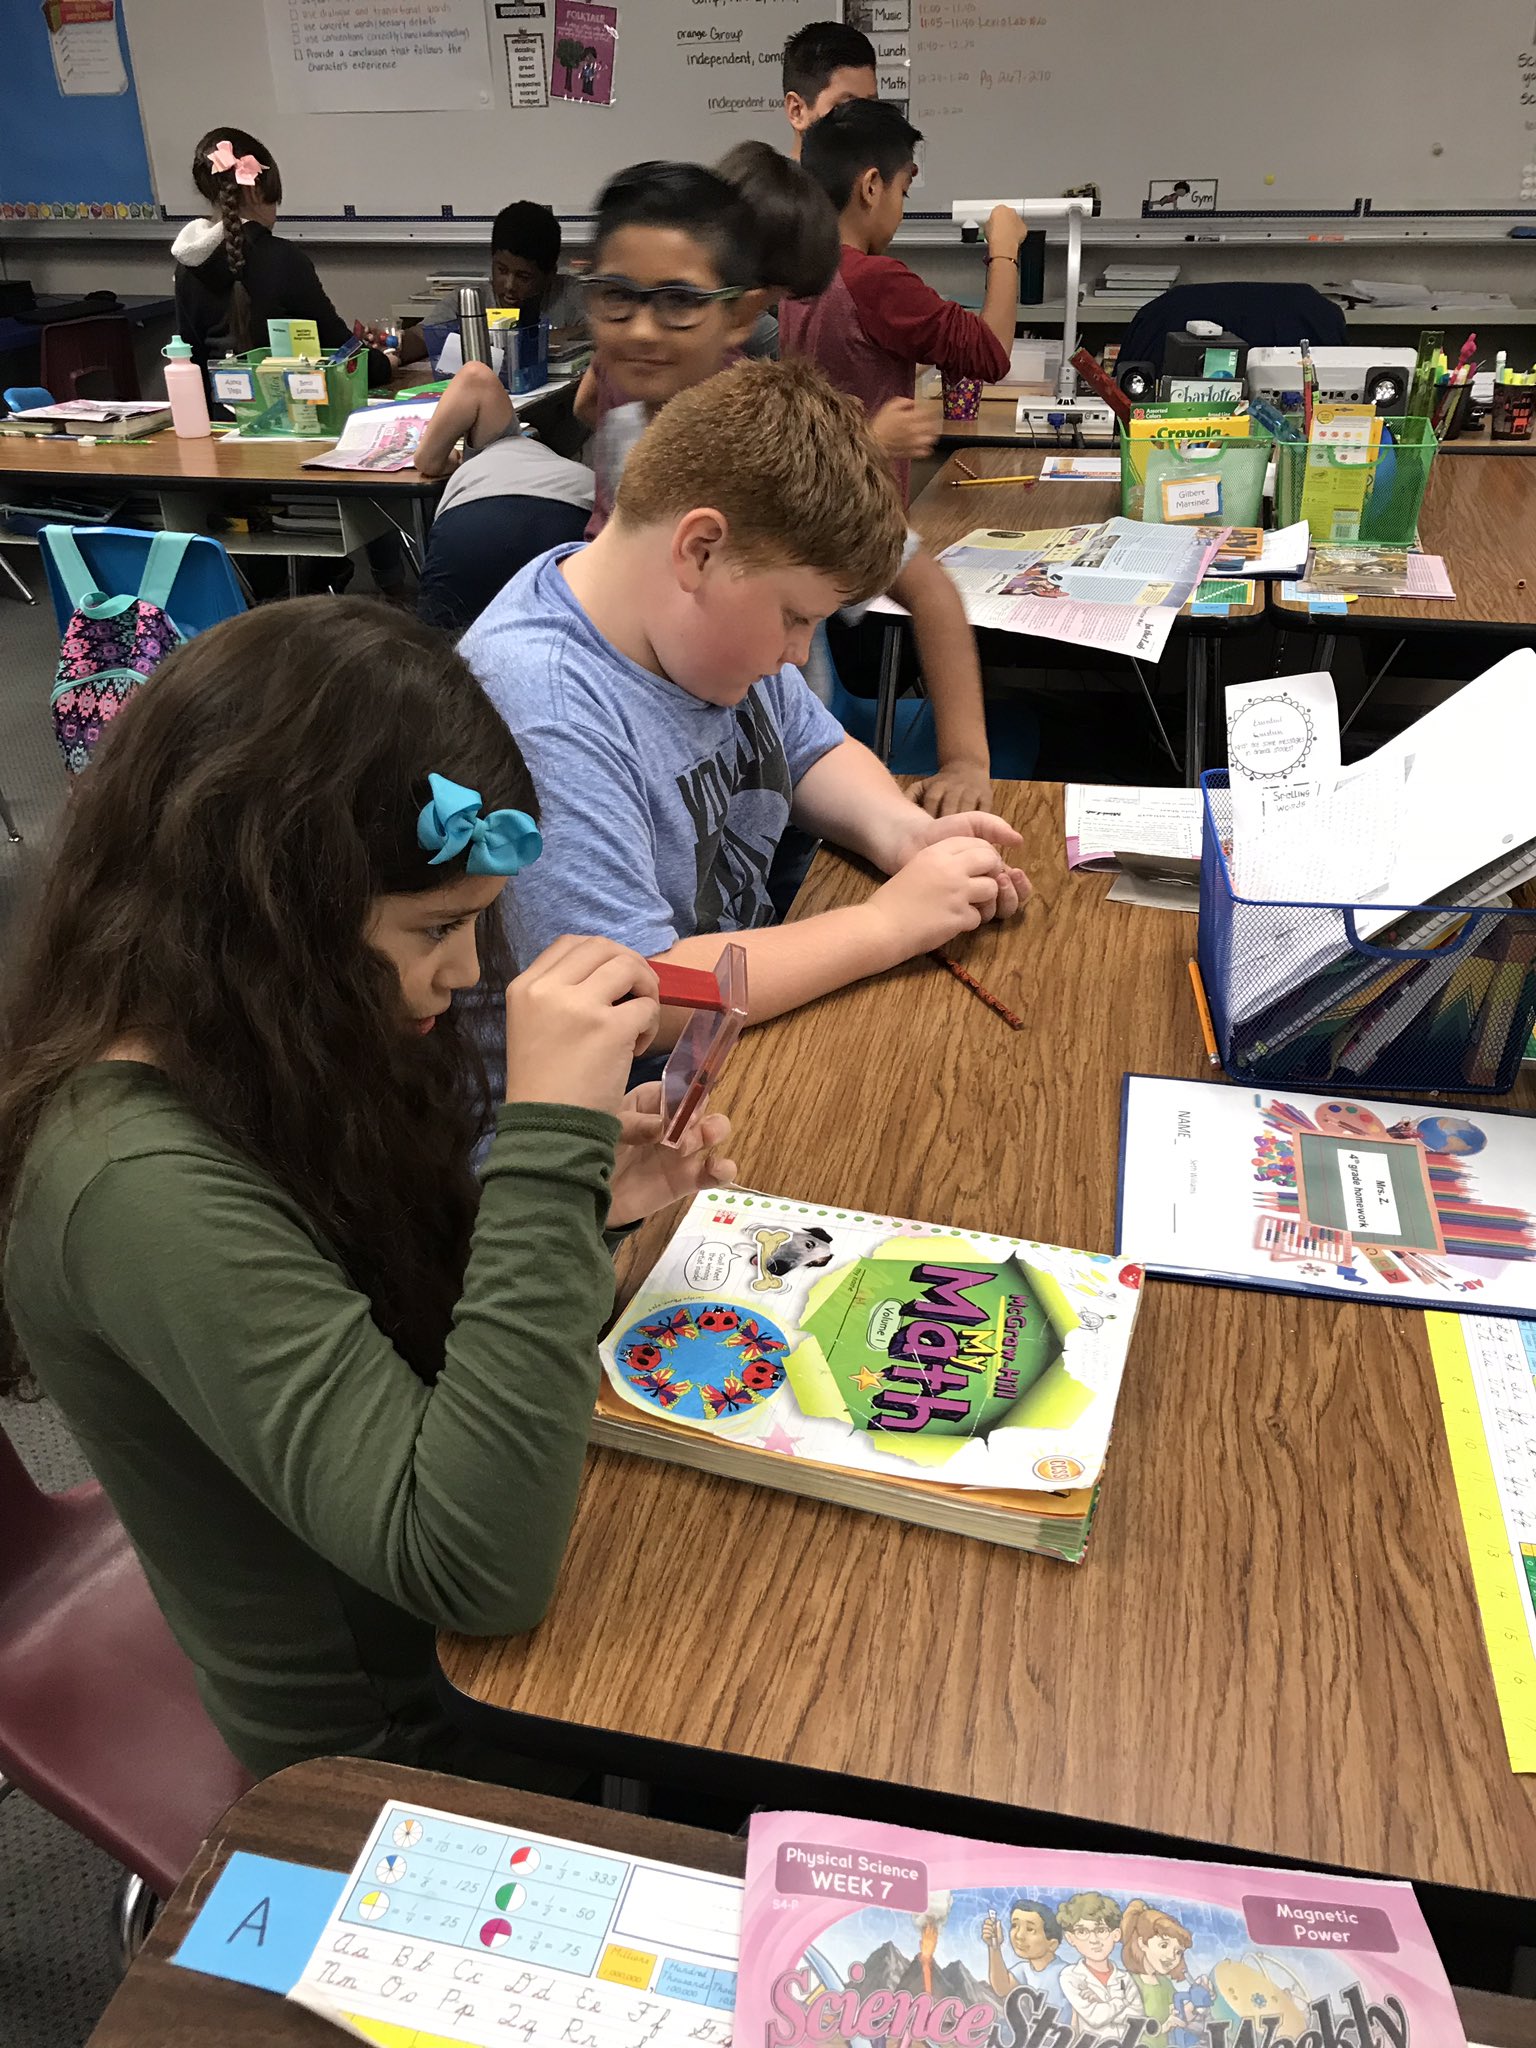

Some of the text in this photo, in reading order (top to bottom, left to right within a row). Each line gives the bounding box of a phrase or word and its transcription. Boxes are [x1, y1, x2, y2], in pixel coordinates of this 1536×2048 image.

[875, 9, 902, 21] Music
[710, 27, 744, 43] Group
[306, 48, 334, 58] Provide
[348, 47, 387, 57] conclusion
[391, 46, 409, 55] that
[414, 44, 443, 55] follows
[448, 43, 461, 54] the
[878, 44, 906, 57] Lunch
[881, 77, 907, 90] Math
[1191, 190, 1213, 207] Gym
[1157, 426, 1222, 439] Crayola
[1176, 498, 1210, 509] Martinez
[1178, 489, 1206, 499] Gilbert
[1137, 639, 1149, 650] Lab
[1177, 1110, 1191, 1139] NAME
[1348, 1164, 1362, 1186] grade
[1376, 1180, 1389, 1205] Mrs. Z.
[1354, 1187, 1369, 1228] homework
[848, 1277, 858, 1292] name
[877, 1307, 895, 1336] Volume
[867, 1262, 999, 1433] Math
[950, 1327, 999, 1374] My
[993, 1294, 1030, 1400] McGraw-Hill
[1046, 1460, 1070, 1481] CCSS
[785, 1847, 919, 1881] Physical Science
[811, 1870, 894, 1900] WEEK 7
[772, 1898, 800, 1911] S4-P
[1276, 1903, 1360, 1924] Magnetic
[226, 1896, 271, 1948] A
[1293, 1924, 1351, 1943] Power
[765, 1961, 998, 2048] Science
